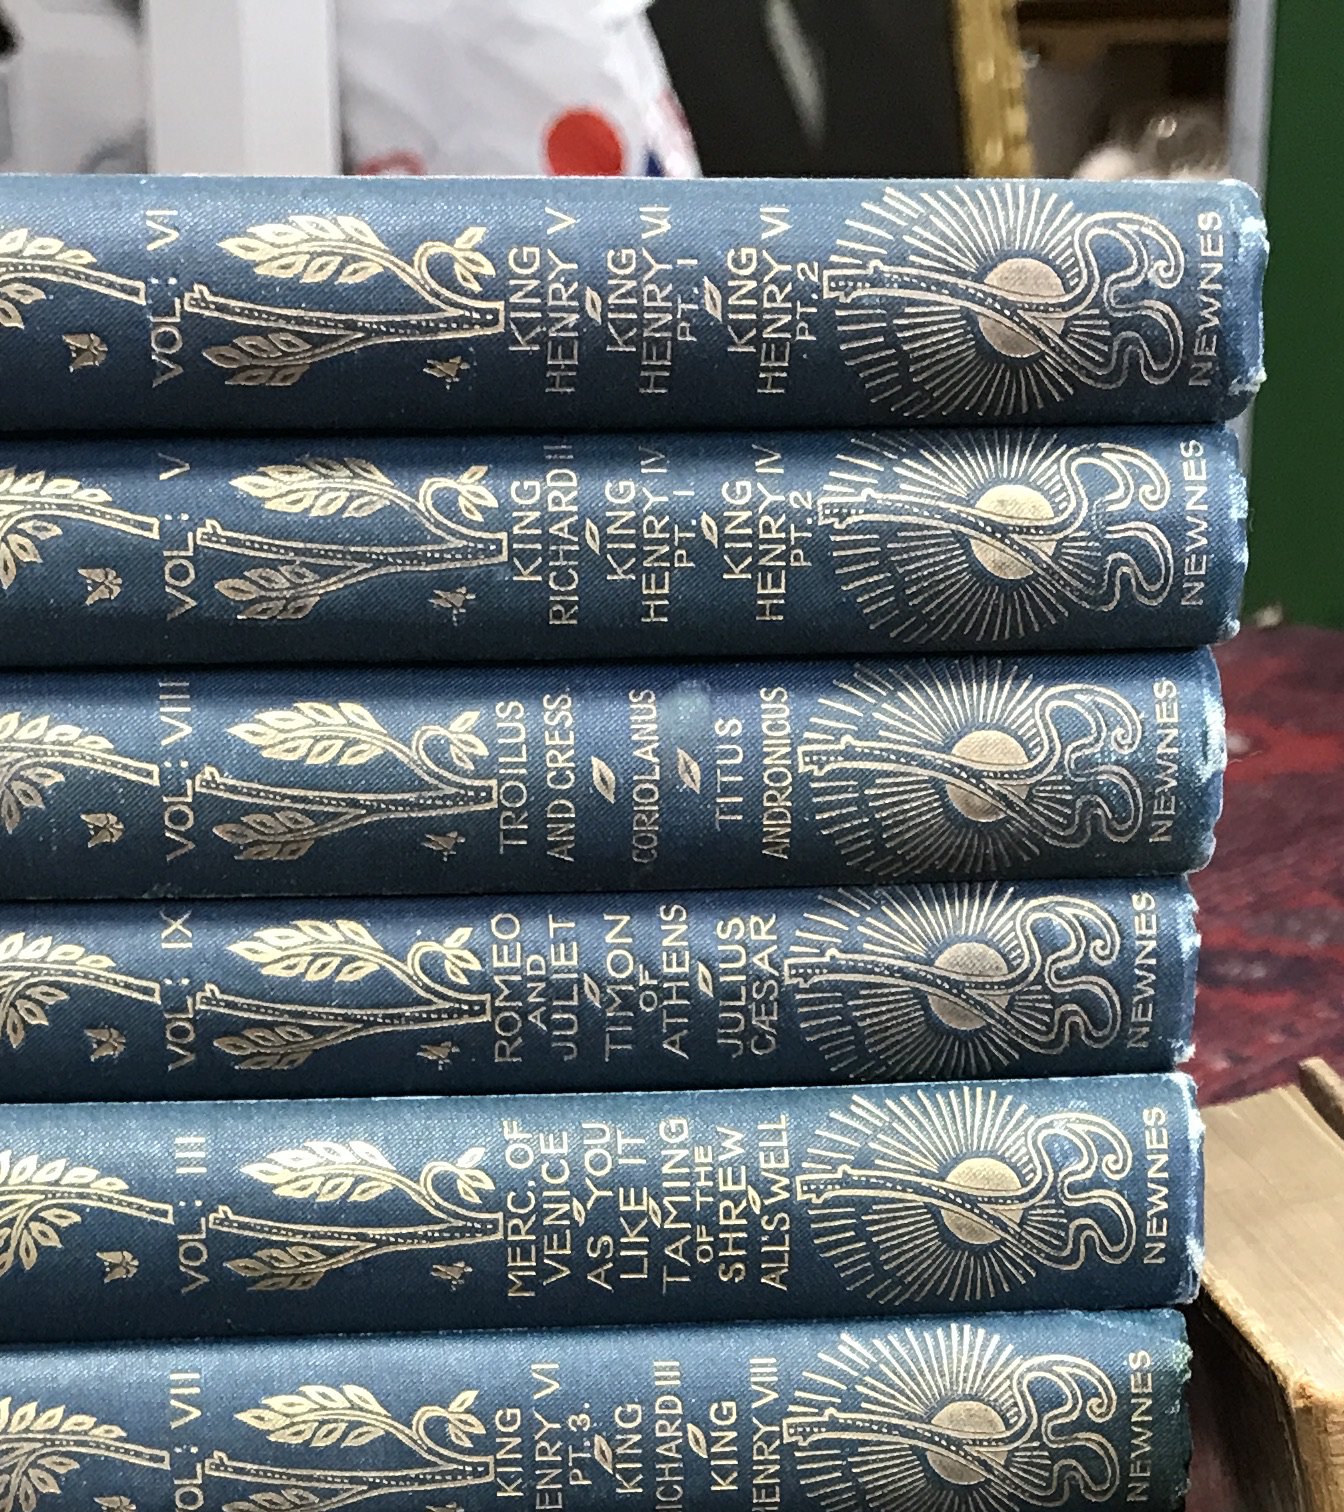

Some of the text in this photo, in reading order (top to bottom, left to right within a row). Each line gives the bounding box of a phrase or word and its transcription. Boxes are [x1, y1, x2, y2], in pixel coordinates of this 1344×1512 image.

[146, 209, 178, 250] VI
[508, 246, 542, 351] KING
[545, 205, 579, 393] HENRY V
[607, 247, 636, 351] KING
[639, 206, 672, 393] HENRY VI
[676, 287, 698, 341] PT.
[727, 246, 757, 352] KING
[757, 206, 792, 393] HENRY VI
[796, 261, 819, 341] PT. 2
[1188, 210, 1225, 387] NEWNES
[158, 453, 190, 479] V
[1180, 439, 1208, 606] NEWNES
[511, 480, 542, 581] KING
[548, 467, 578, 625] RICHARD
[605, 480, 635, 580] KING
[638, 445, 669, 622] HENRY IV
[673, 519, 696, 568] PT.
[722, 480, 752, 579] KING
[752, 444, 786, 621] HENRY IV
[790, 490, 813, 567] PT. 2
[158, 681, 192, 746] VIII
[1149, 680, 1177, 843] NEWNES
[496, 700, 529, 854] TROILUS
[547, 800, 575, 862] AND
[629, 688, 659, 863] CORIOLANUS
[716, 717, 743, 831] TITUS
[760, 686, 791, 859] ANDRONICUS
[161, 909, 193, 949] IX
[490, 912, 522, 1062] ROMEO
[550, 914, 578, 1060] JULIET
[603, 913, 633, 1061] TIMON
[639, 963, 657, 1012] OF
[660, 903, 690, 1059] ATHENS
[716, 916, 746, 1058] JULIUS
[1128, 892, 1157, 1048] NEWNES
[528, 955, 548, 1031] AND
[175, 1136, 206, 1174] III
[504, 1118, 536, 1297] MERC. OF
[539, 1131, 571, 1284] VENICE
[584, 1121, 614, 1290] AS YOU
[617, 1127, 650, 1280] LIKE IT
[658, 1116, 692, 1293] TAMING
[695, 1145, 714, 1265] OF THE
[716, 1126, 749, 1283] SHREW
[757, 1113, 790, 1210] WELL
[1142, 1106, 1169, 1264] NEWNES
[169, 1371, 203, 1429] VII
[531, 1361, 559, 1400] VI
[653, 1361, 680, 1386] III
[749, 1356, 779, 1401] VIII
[1126, 1350, 1154, 1502] NEWNES
[495, 1407, 523, 1497] KING
[615, 1401, 642, 1493] KING
[710, 1400, 737, 1491] KING
